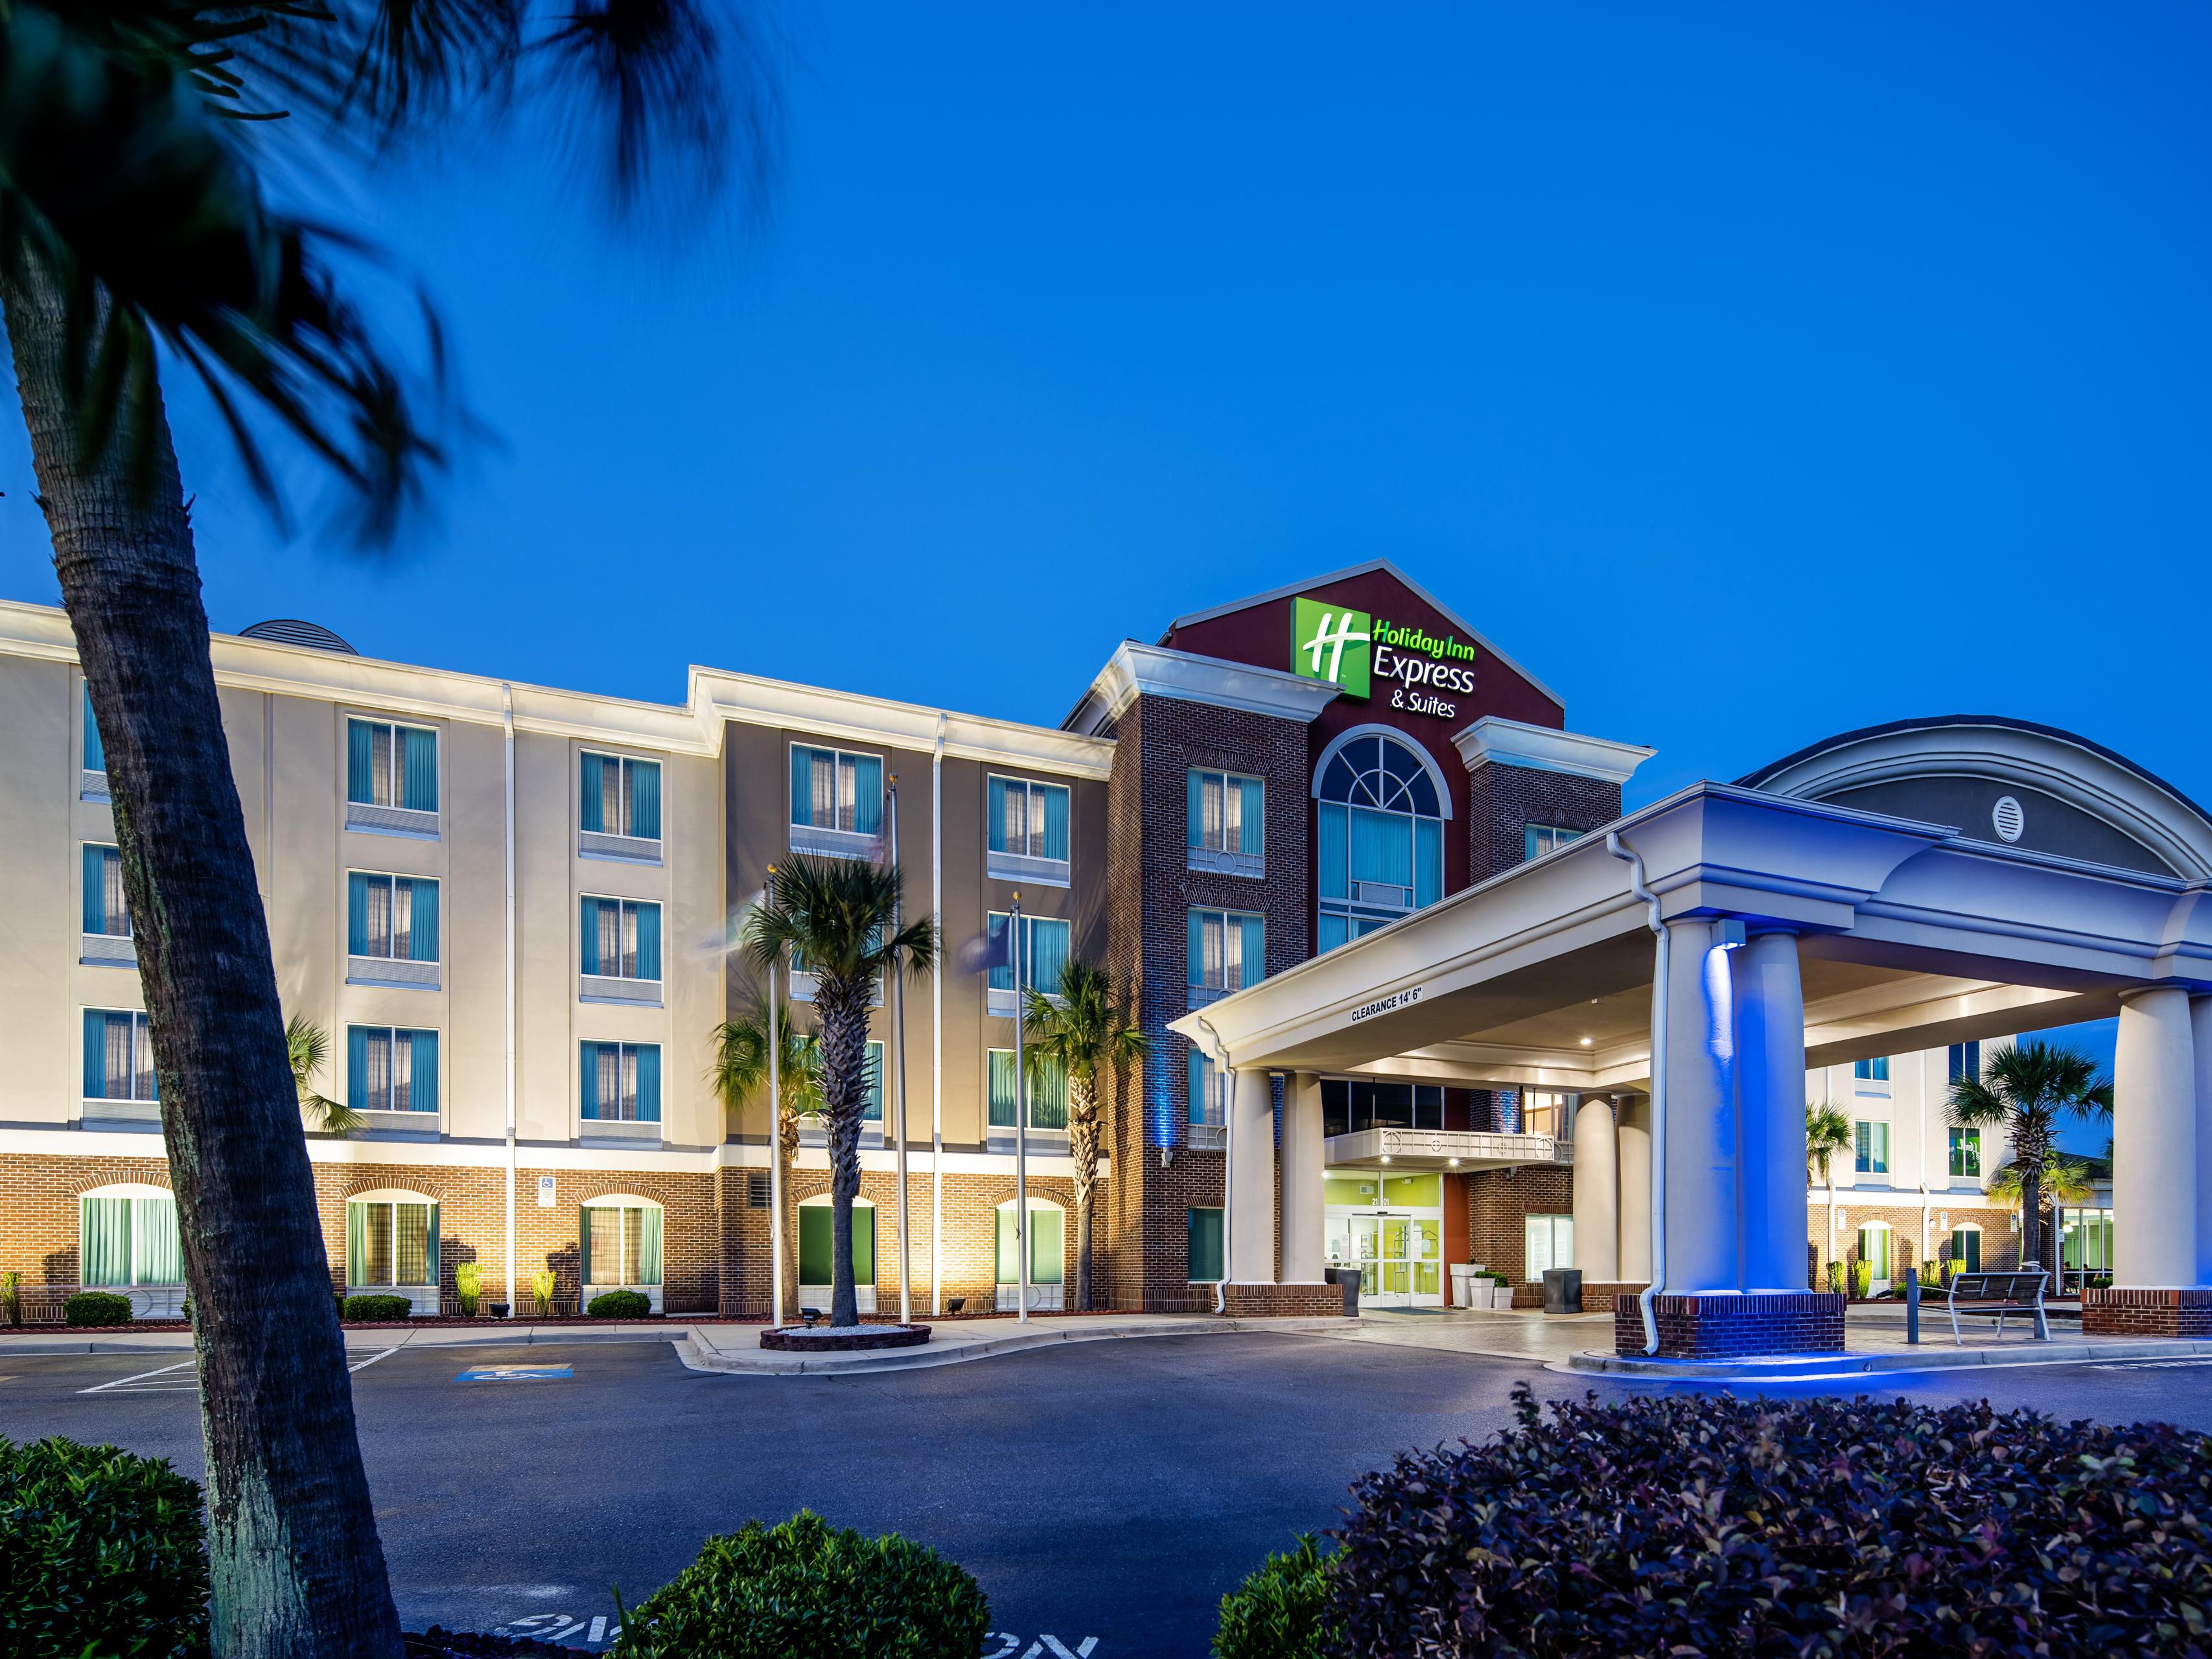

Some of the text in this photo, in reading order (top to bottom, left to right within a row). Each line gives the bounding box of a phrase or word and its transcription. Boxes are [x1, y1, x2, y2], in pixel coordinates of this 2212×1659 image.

[1373, 620, 1474, 662] Holiday Inn
[1373, 645, 1474, 693] Express
[1391, 690, 1456, 718] & Suites
[1352, 997, 1396, 1021] CLEARANCE
